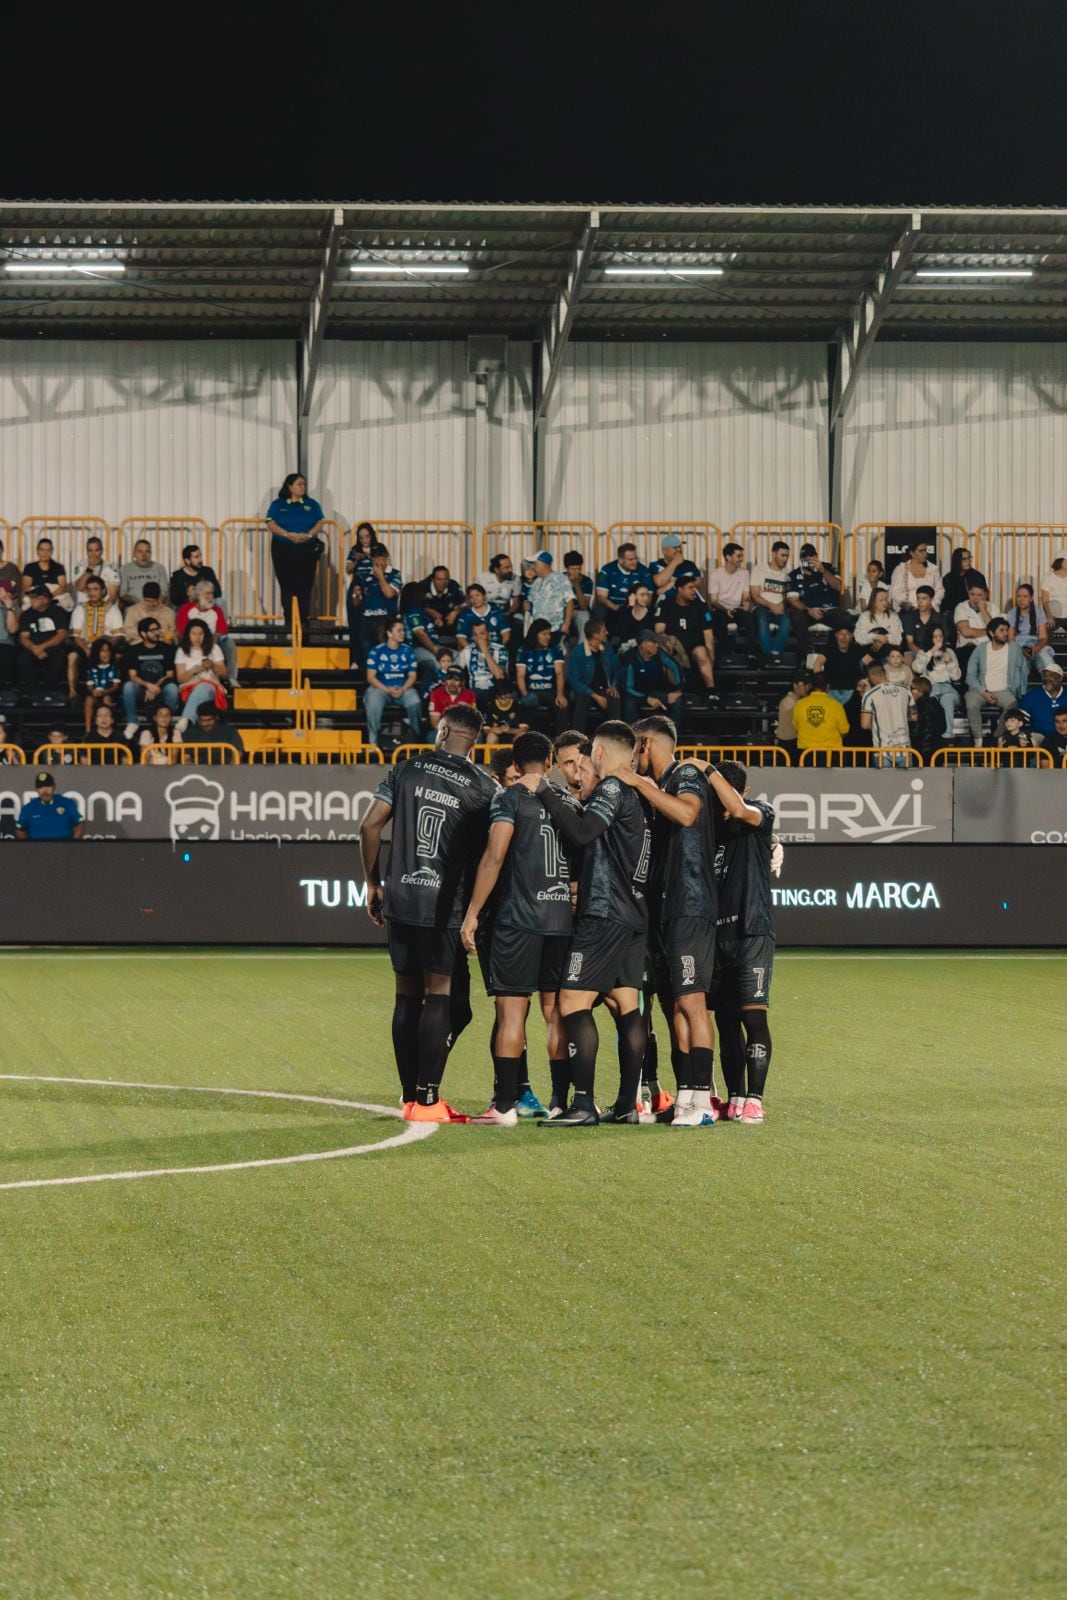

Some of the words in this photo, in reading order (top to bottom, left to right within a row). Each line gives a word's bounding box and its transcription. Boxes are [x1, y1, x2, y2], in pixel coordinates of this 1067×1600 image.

[423, 762, 472, 786] MEDCARE
[424, 788, 461, 809] GEORGE
[416, 805, 446, 859] 9
[299, 879, 341, 907] TU
[770, 889, 837, 906] TING.CR
[846, 882, 941, 909] MARCA
[681, 955, 696, 978] 3
[752, 967, 765, 990] 7
